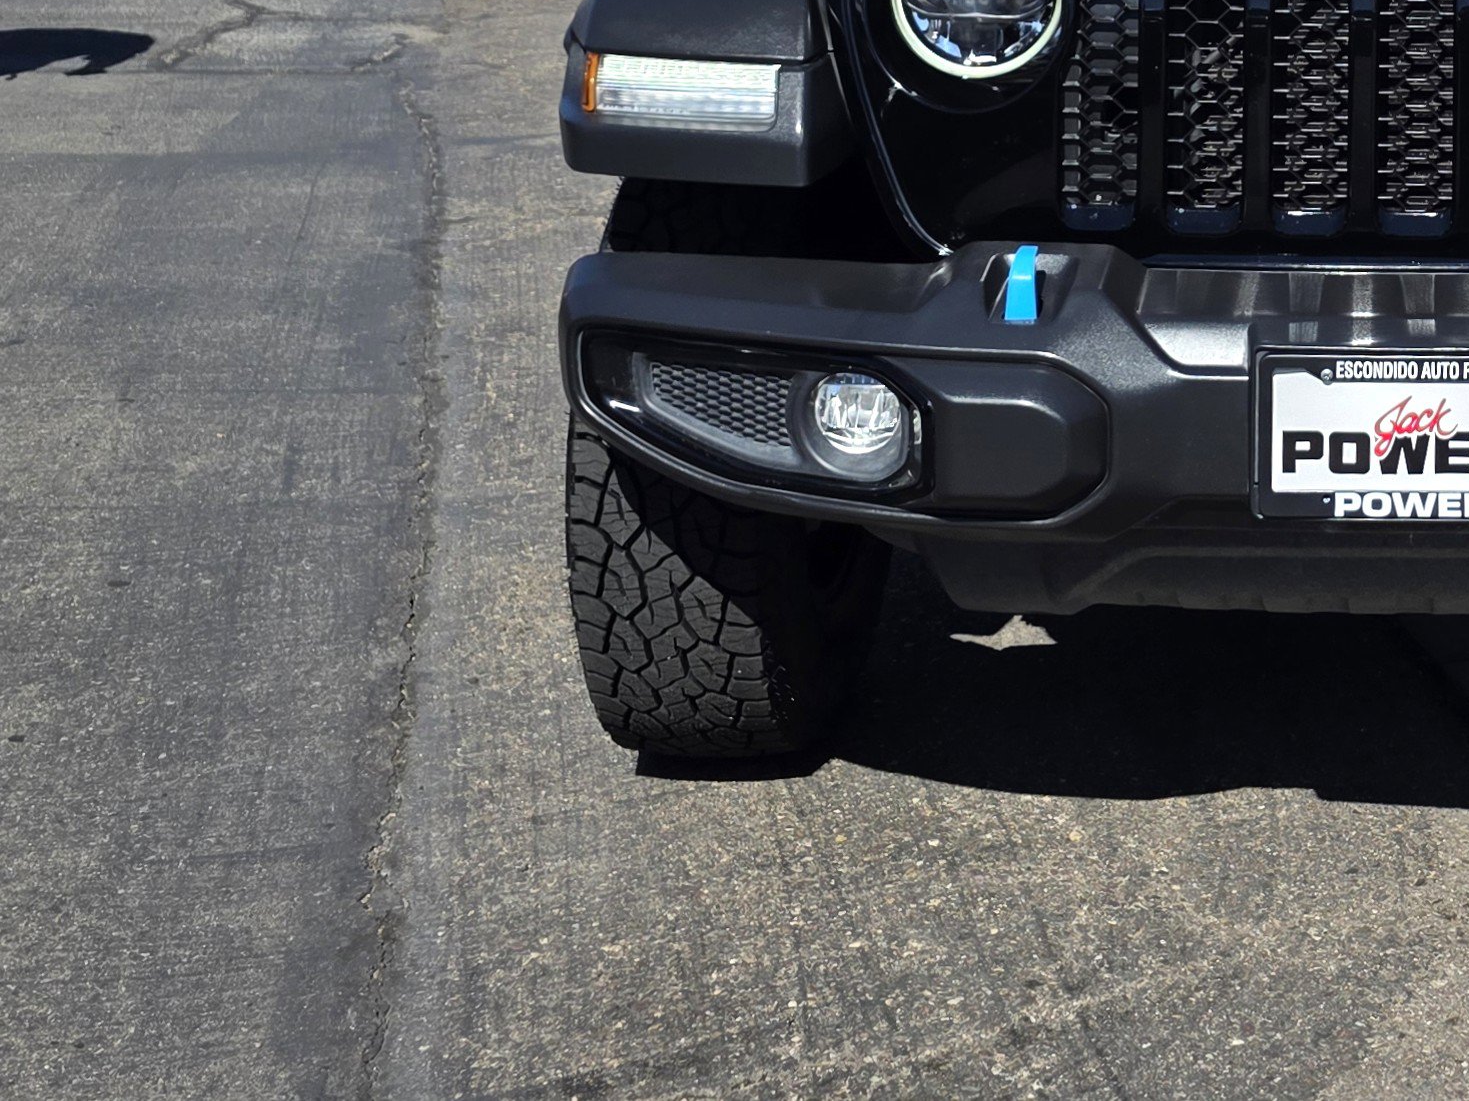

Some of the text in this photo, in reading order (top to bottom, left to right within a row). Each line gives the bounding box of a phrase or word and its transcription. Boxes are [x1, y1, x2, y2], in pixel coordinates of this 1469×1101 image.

[1335, 360, 1419, 381] ESCONDIDO
[1421, 360, 1460, 381] AUTO
[1373, 395, 1458, 457] Jack
